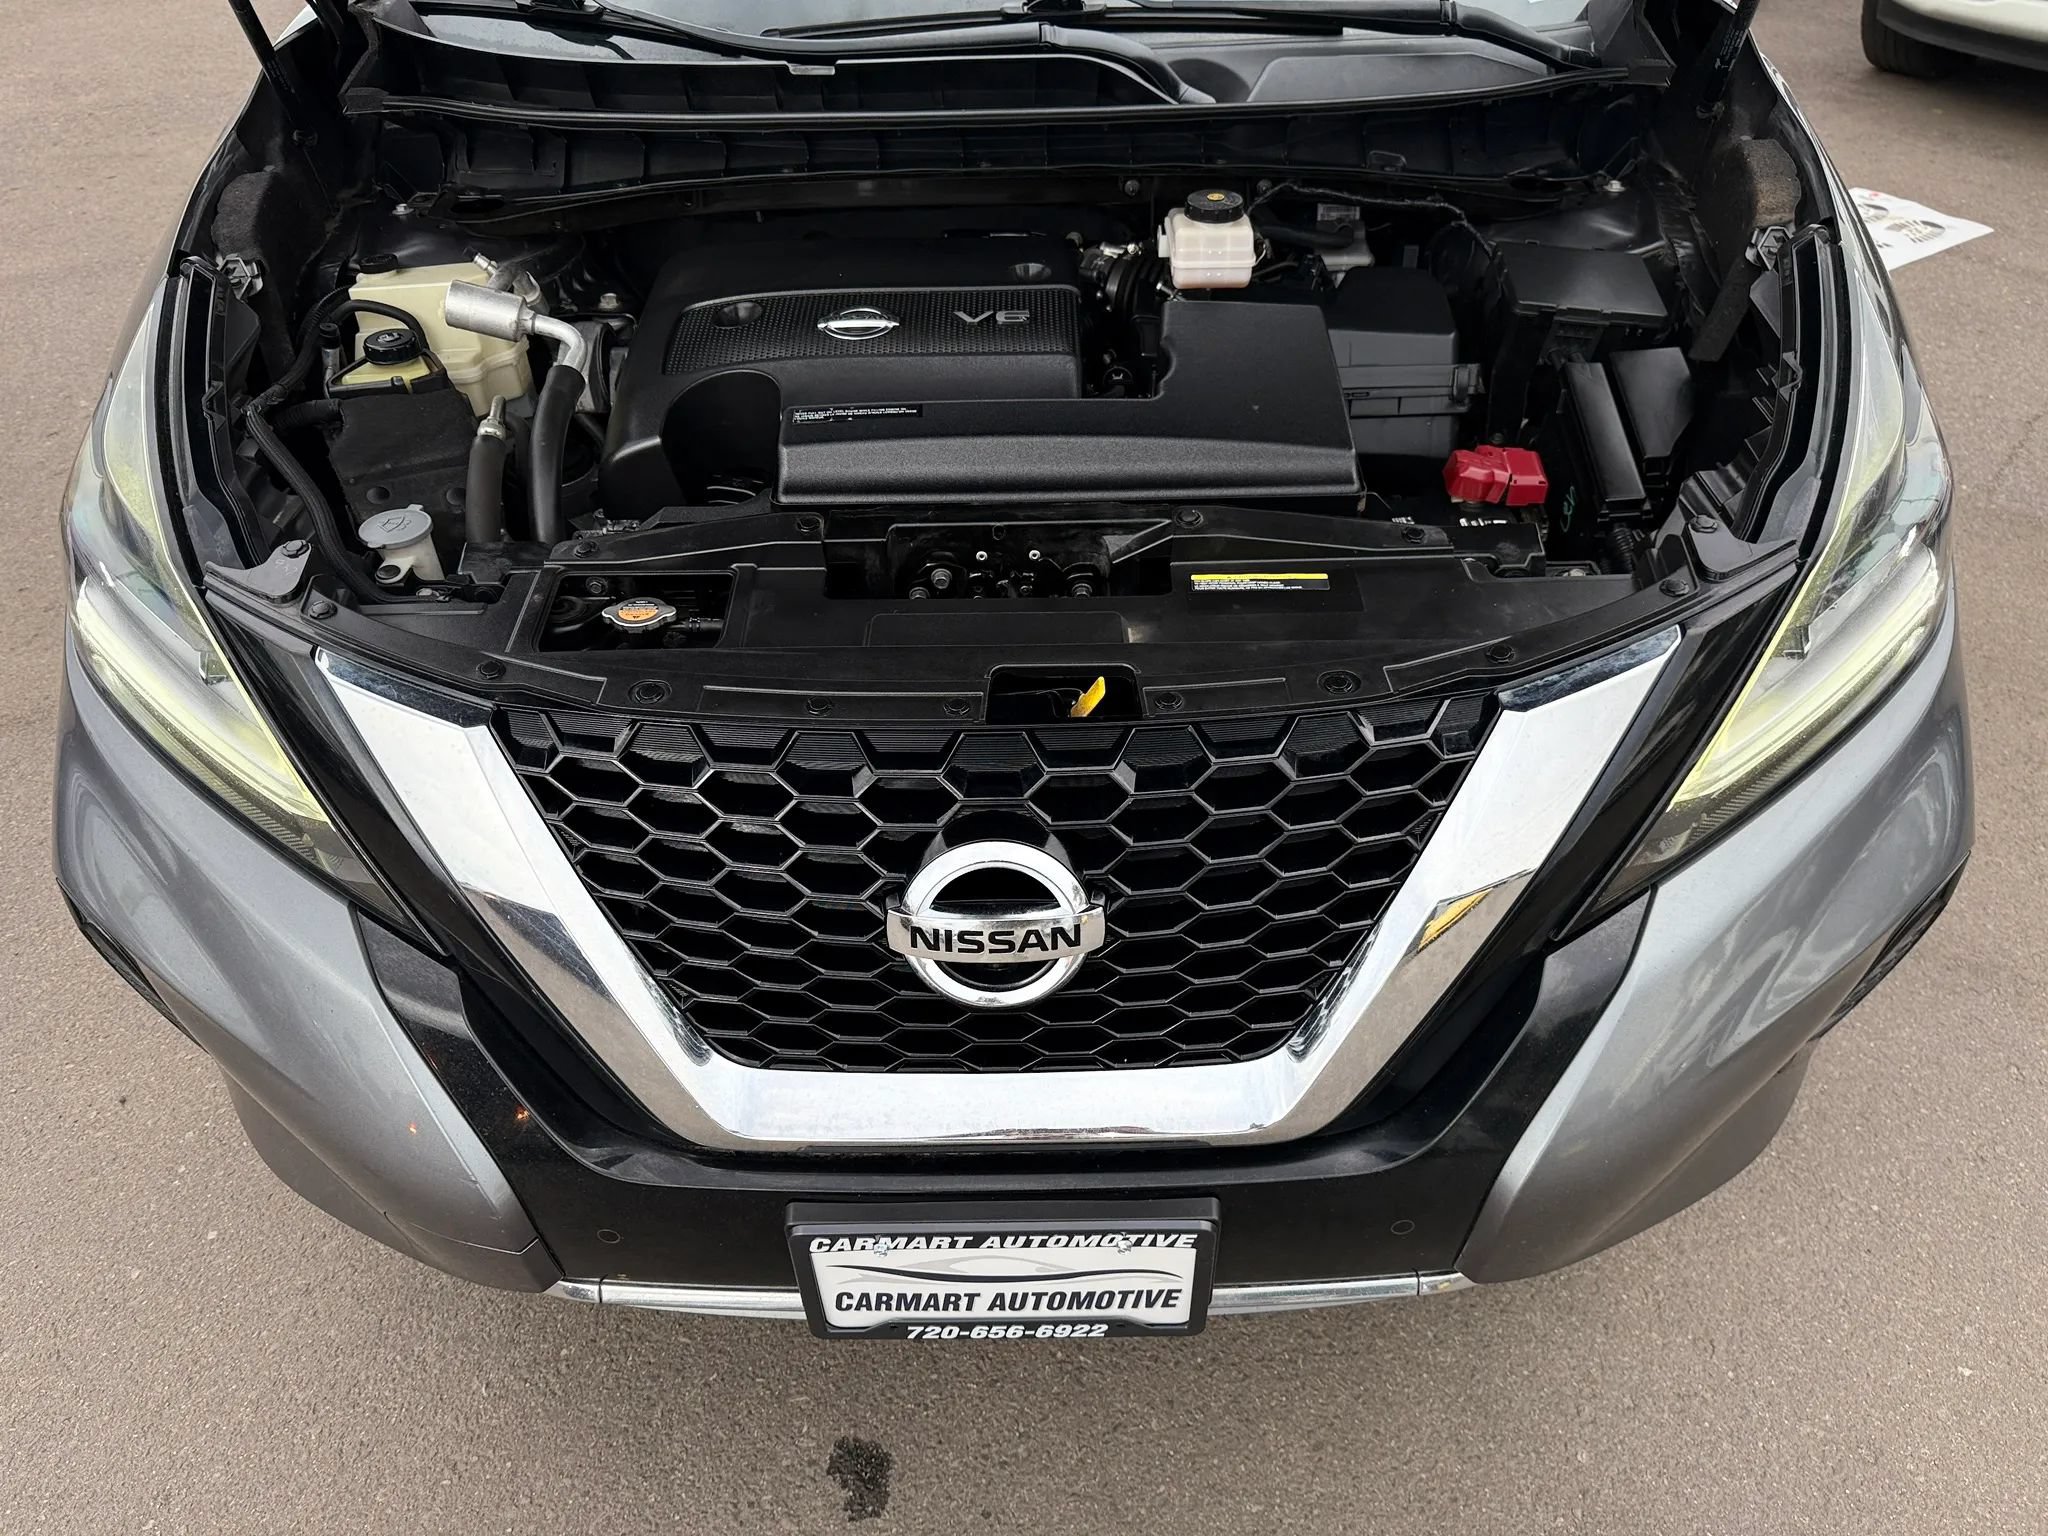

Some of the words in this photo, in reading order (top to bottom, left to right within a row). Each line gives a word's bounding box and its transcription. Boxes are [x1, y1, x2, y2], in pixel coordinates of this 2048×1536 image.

[953, 309, 1030, 323] V6
[910, 923, 1081, 954] NISSAN
[809, 1235, 974, 1253] CARMART
[979, 1233, 1198, 1249] AUTOMOTIVE
[835, 1291, 981, 1312] CARMART
[987, 1288, 1183, 1311] AUTOMOTIVE
[907, 1323, 1109, 1340] 720-656-6922
